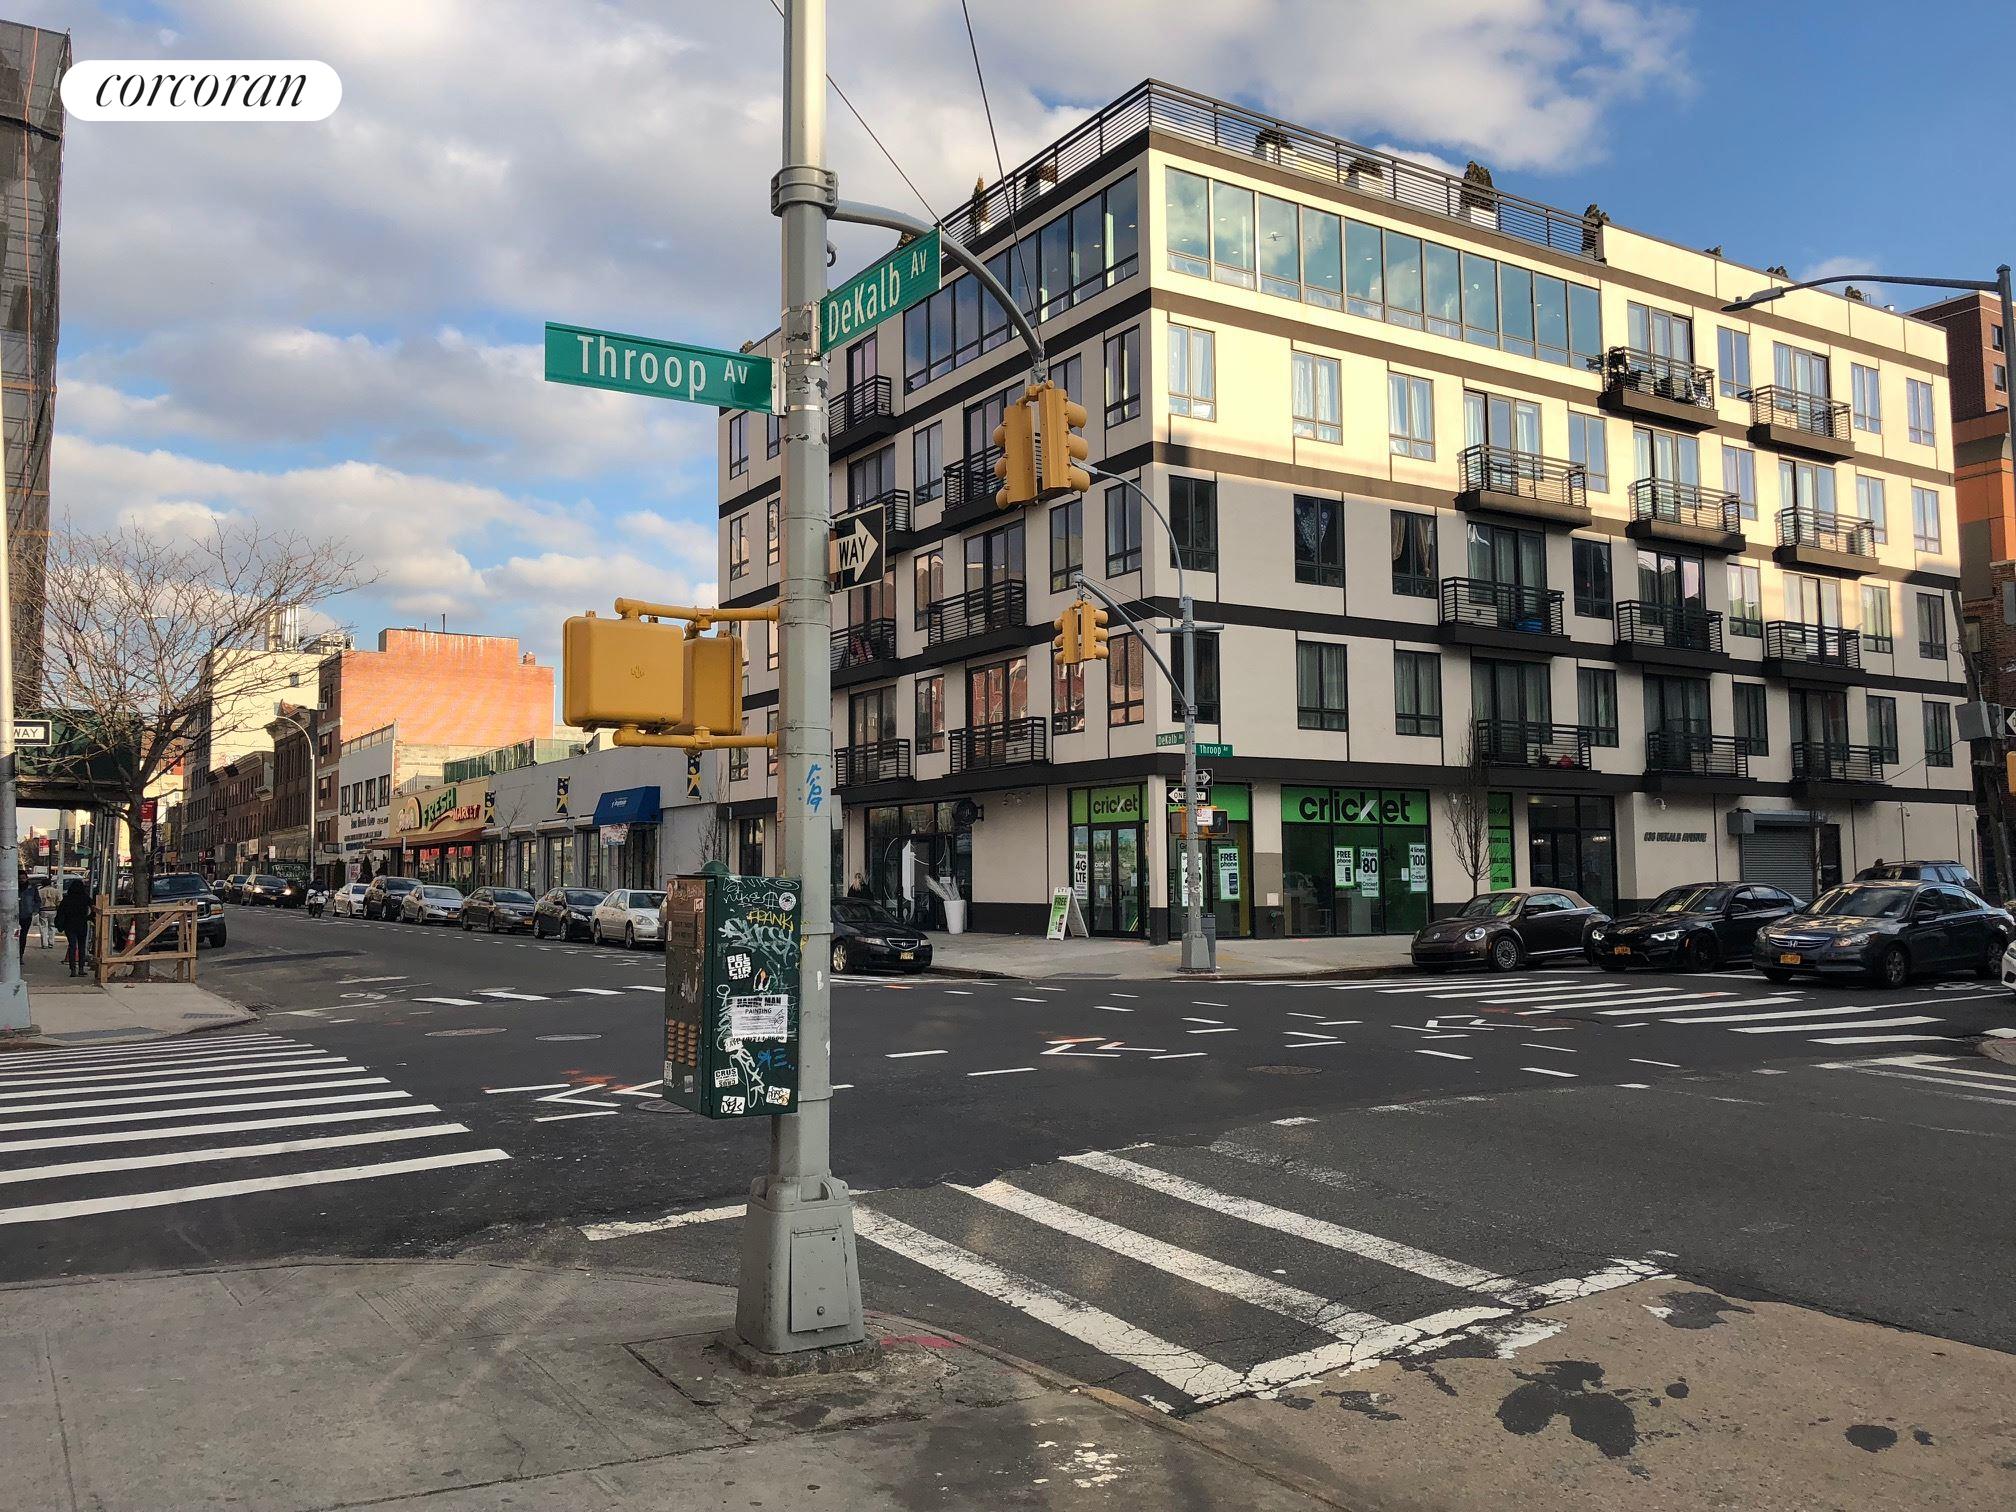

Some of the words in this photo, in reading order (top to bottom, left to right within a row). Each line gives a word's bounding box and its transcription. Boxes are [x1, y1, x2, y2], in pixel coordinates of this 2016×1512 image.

[828, 261, 900, 342] DeKalb
[910, 249, 927, 279] Av
[577, 335, 706, 401] Throop
[724, 359, 748, 384] Av
[838, 534, 868, 568] WAY
[1157, 733, 1178, 746] DeKalb
[1200, 744, 1221, 756] Throop
[424, 787, 456, 827] FRESH
[1094, 794, 1138, 815] cricket
[1299, 792, 1410, 822] cricket
[452, 804, 481, 821] MARKET
[1220, 853, 1237, 861] FREE
[1075, 860, 1086, 871] 4G
[1075, 872, 1086, 883] LTE
[746, 909, 793, 932] FRANK
[727, 953, 750, 963] BEL
[728, 960, 751, 970] LOS
[728, 966, 752, 977] CIR
[764, 996, 781, 1005] MAN
[715, 1069, 737, 1077] CRUS
